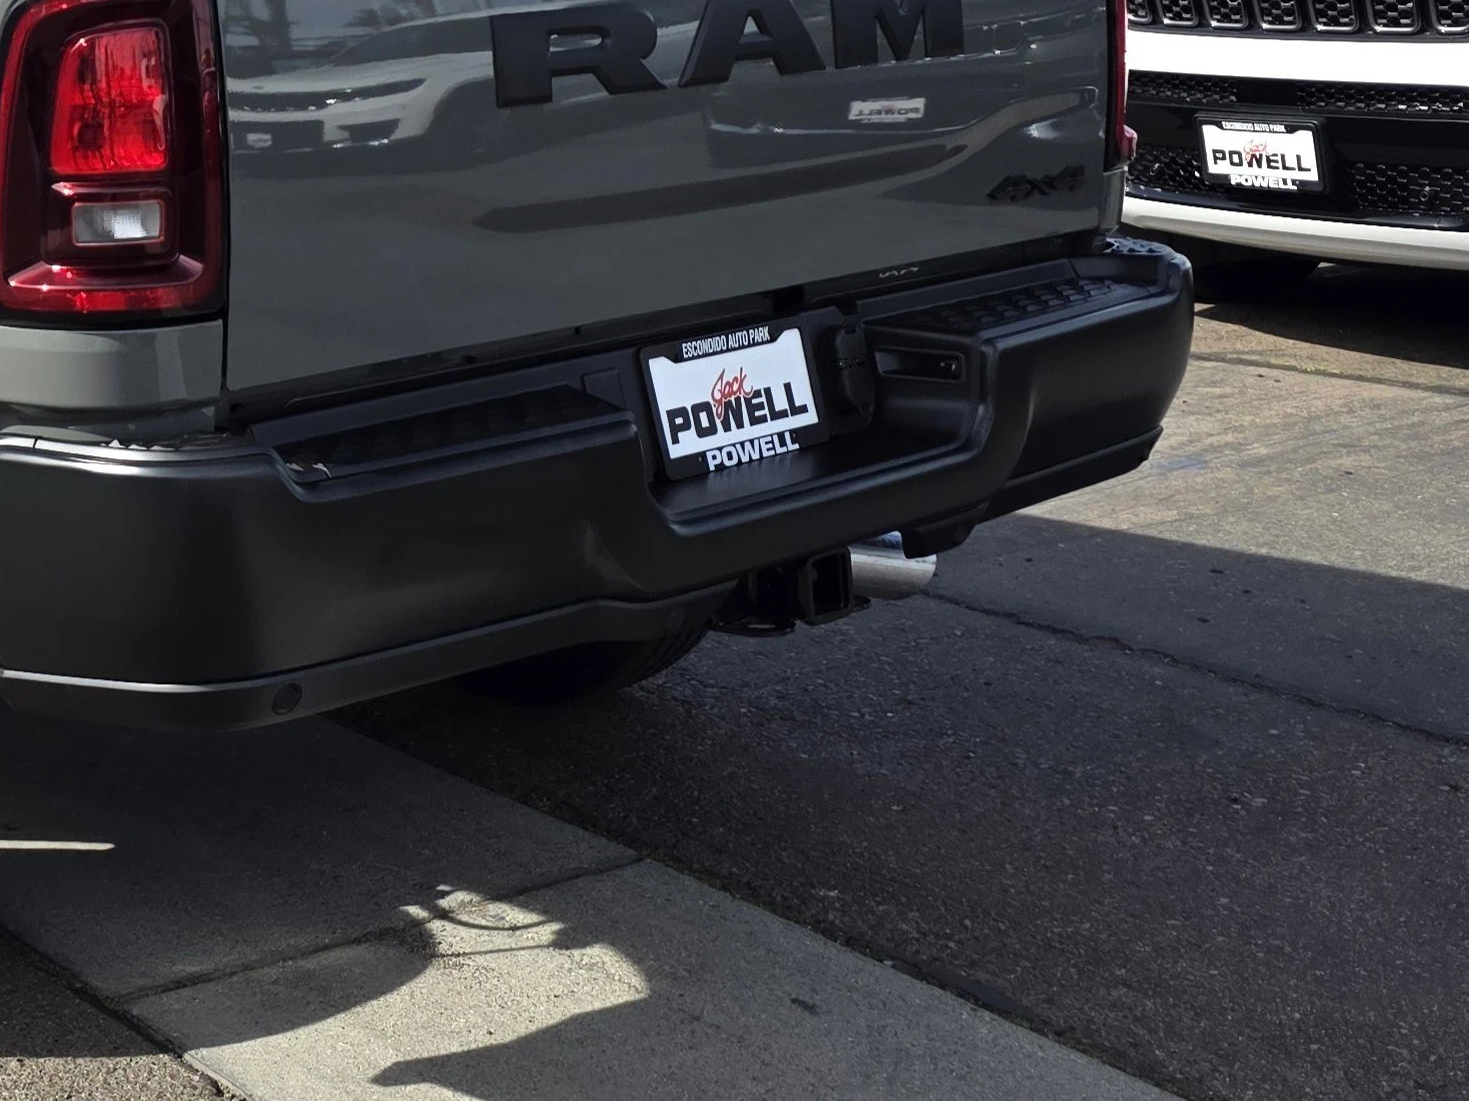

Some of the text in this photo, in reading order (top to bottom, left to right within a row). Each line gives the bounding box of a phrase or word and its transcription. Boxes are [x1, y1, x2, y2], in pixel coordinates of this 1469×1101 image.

[1211, 148, 1312, 172] POWELL
[1229, 174, 1298, 190] POWELL
[682, 326, 770, 358] ESCONDIDO AUTO PARK
[710, 366, 754, 421] Jack
[665, 381, 809, 445] POWELL
[705, 431, 800, 472] POWELL
